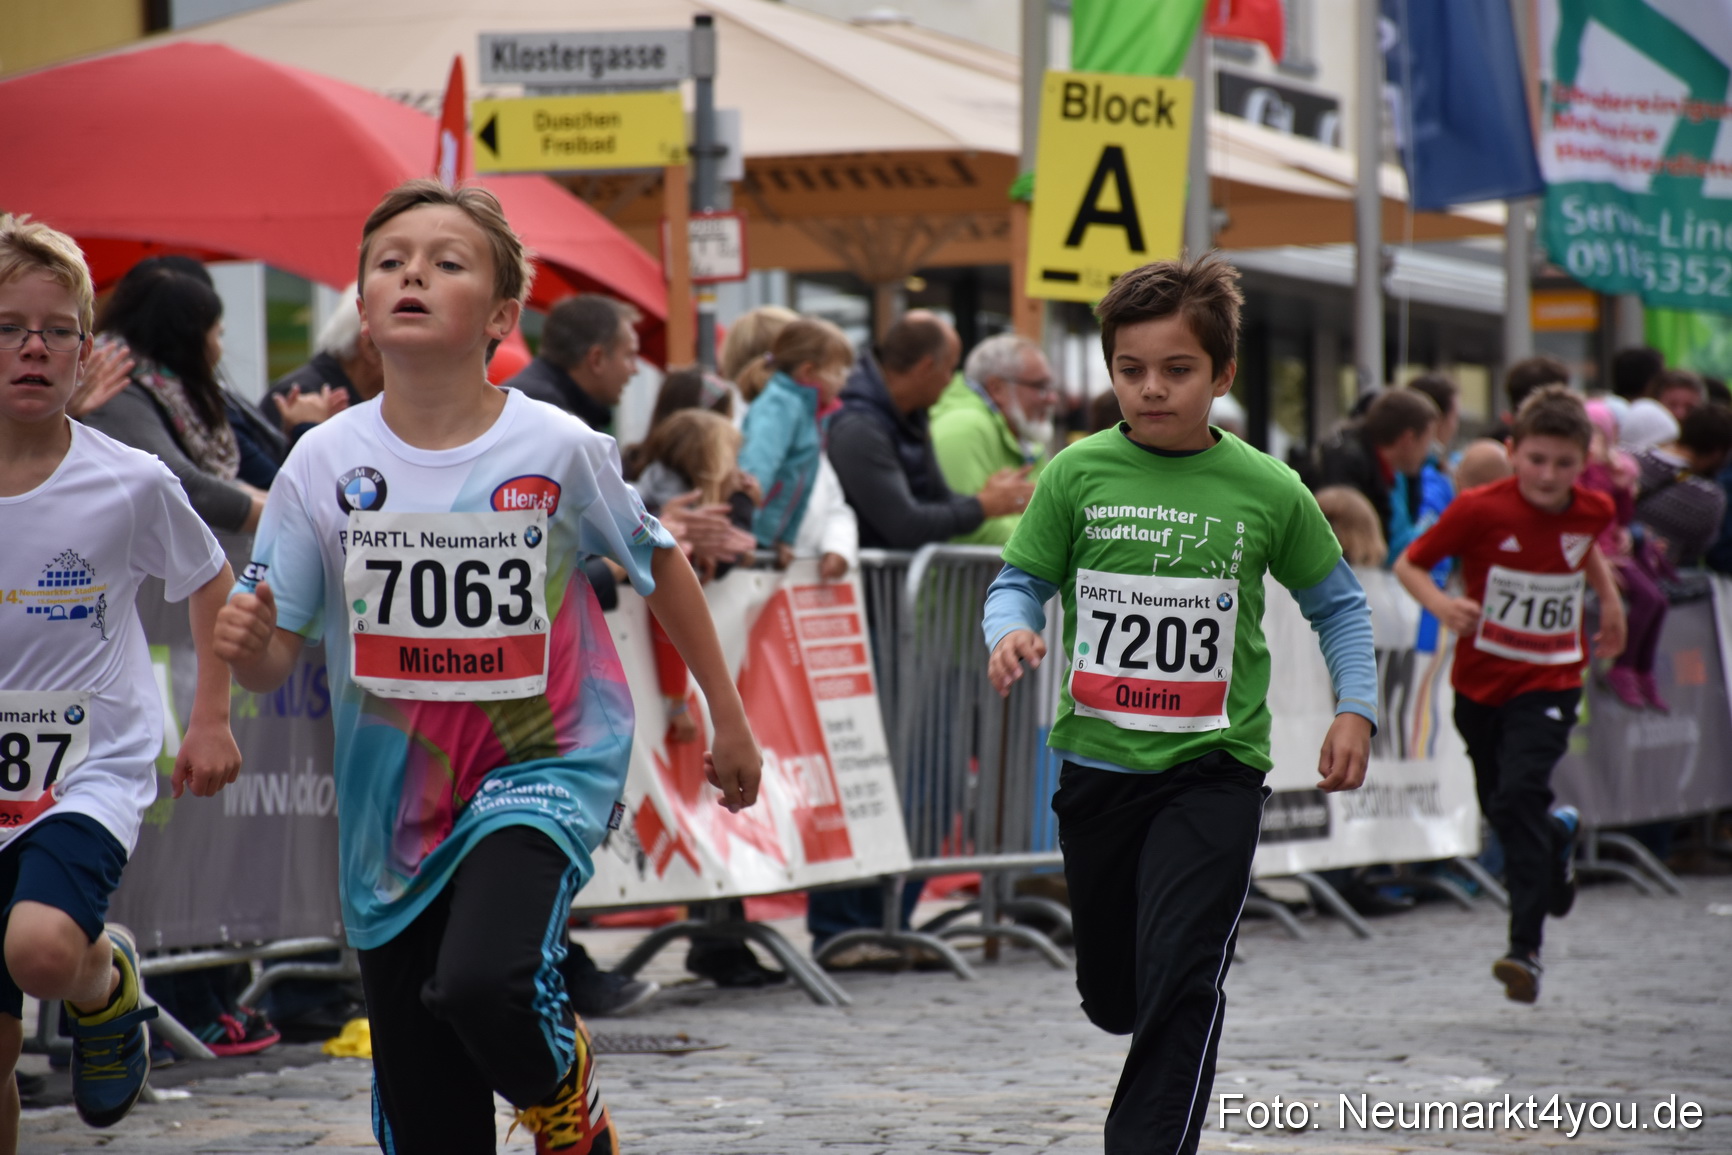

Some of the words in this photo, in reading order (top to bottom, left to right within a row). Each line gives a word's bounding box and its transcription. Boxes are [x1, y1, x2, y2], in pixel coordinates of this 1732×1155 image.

[491, 40, 667, 79] Klostergasse
[1061, 80, 1175, 128] Block
[534, 110, 621, 131] Duschen
[542, 135, 616, 155] Freibad
[1064, 144, 1147, 255] A
[1084, 505, 1197, 524] Neumarkter
[352, 531, 415, 547] PARTL
[421, 531, 517, 549] Neumarkt
[1085, 524, 1173, 547] Stadtlauf
[1229, 521, 1246, 580] BAMB
[19, 588, 72, 597] Neumarkter
[366, 559, 533, 628] 7063
[1080, 585, 1127, 604] PARTL
[1131, 591, 1211, 609] Neumarkt
[1498, 590, 1575, 629] 7166
[357, 620, 365, 631] 6
[534, 620, 541, 630] K
[1092, 610, 1220, 673] 7203
[400, 646, 504, 674] Michael
[1078, 659, 1085, 669] 6
[1217, 669, 1223, 678] K
[1116, 684, 1181, 711] Quirin
